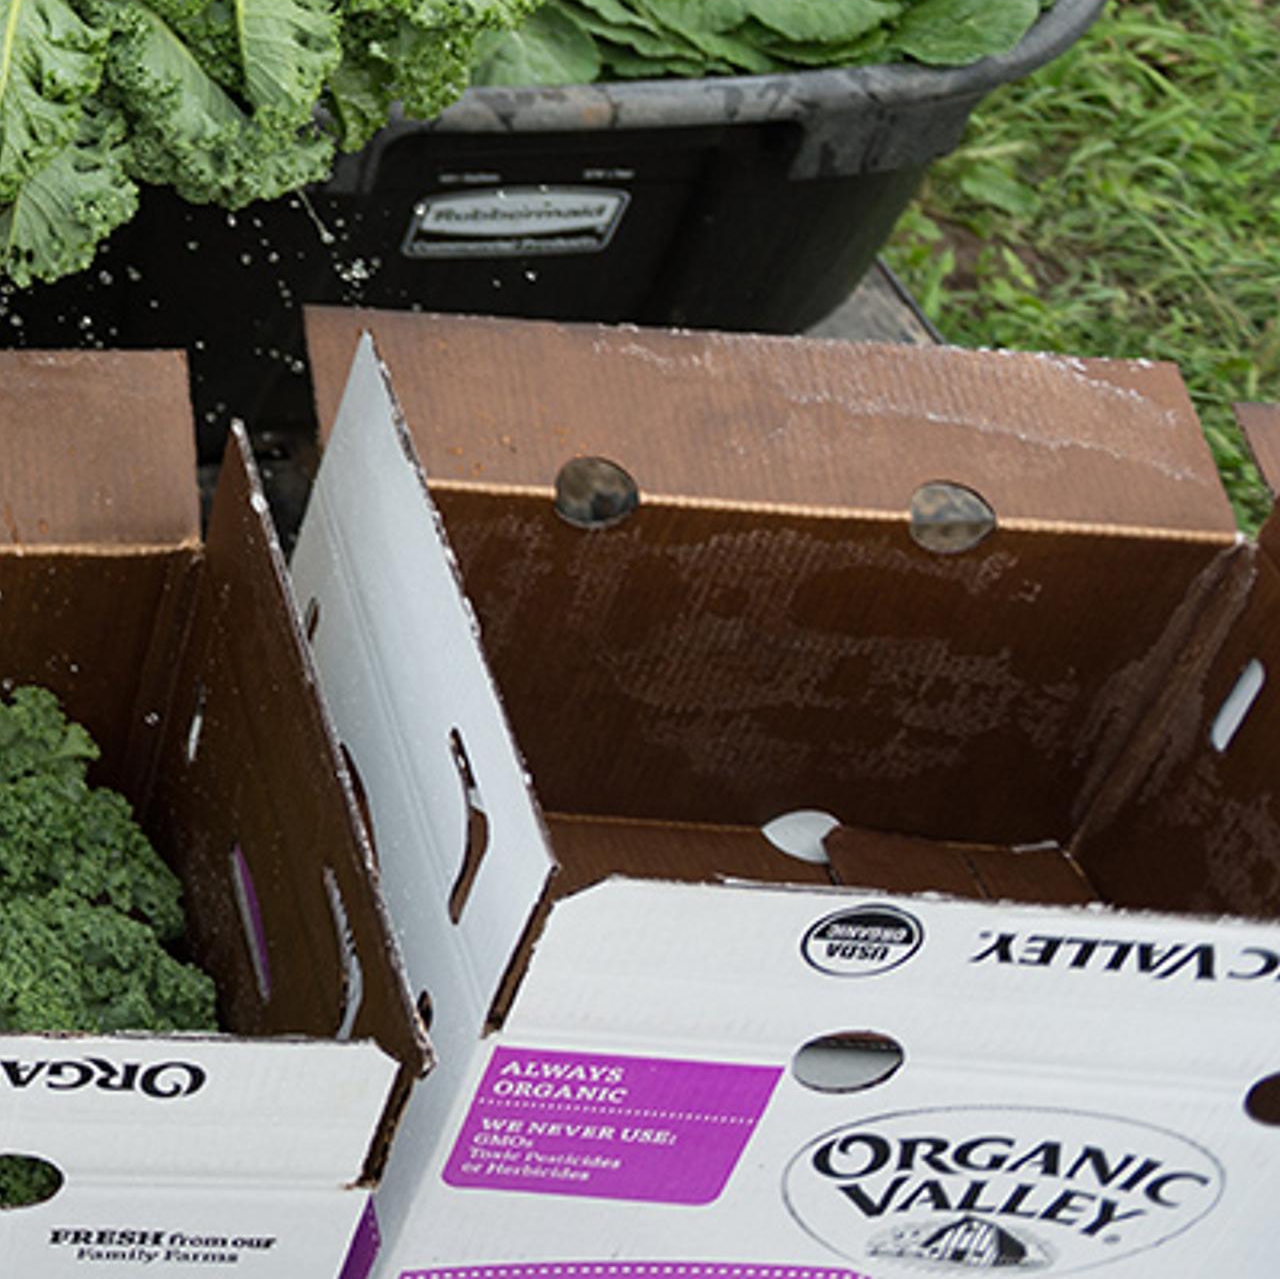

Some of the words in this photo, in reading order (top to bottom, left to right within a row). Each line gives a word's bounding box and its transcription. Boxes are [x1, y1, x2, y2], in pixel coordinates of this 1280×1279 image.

[827, 925, 907, 943] ORGANIC
[826, 943, 890, 961] USDA
[969, 932, 1217, 981] VALLEY
[500, 1060, 626, 1083] ALWAYS
[492, 1079, 629, 1104] ORGANIC
[480, 1118, 523, 1133] WE
[526, 1121, 617, 1141] NEVER
[620, 1128, 678, 1146] USE:
[812, 1133, 1209, 1208] ORGANIC
[837, 1176, 1145, 1237] VALLEY
[50, 1229, 167, 1246] FRESH
[167, 1232, 229, 1248] from
[231, 1236, 277, 1249] our
